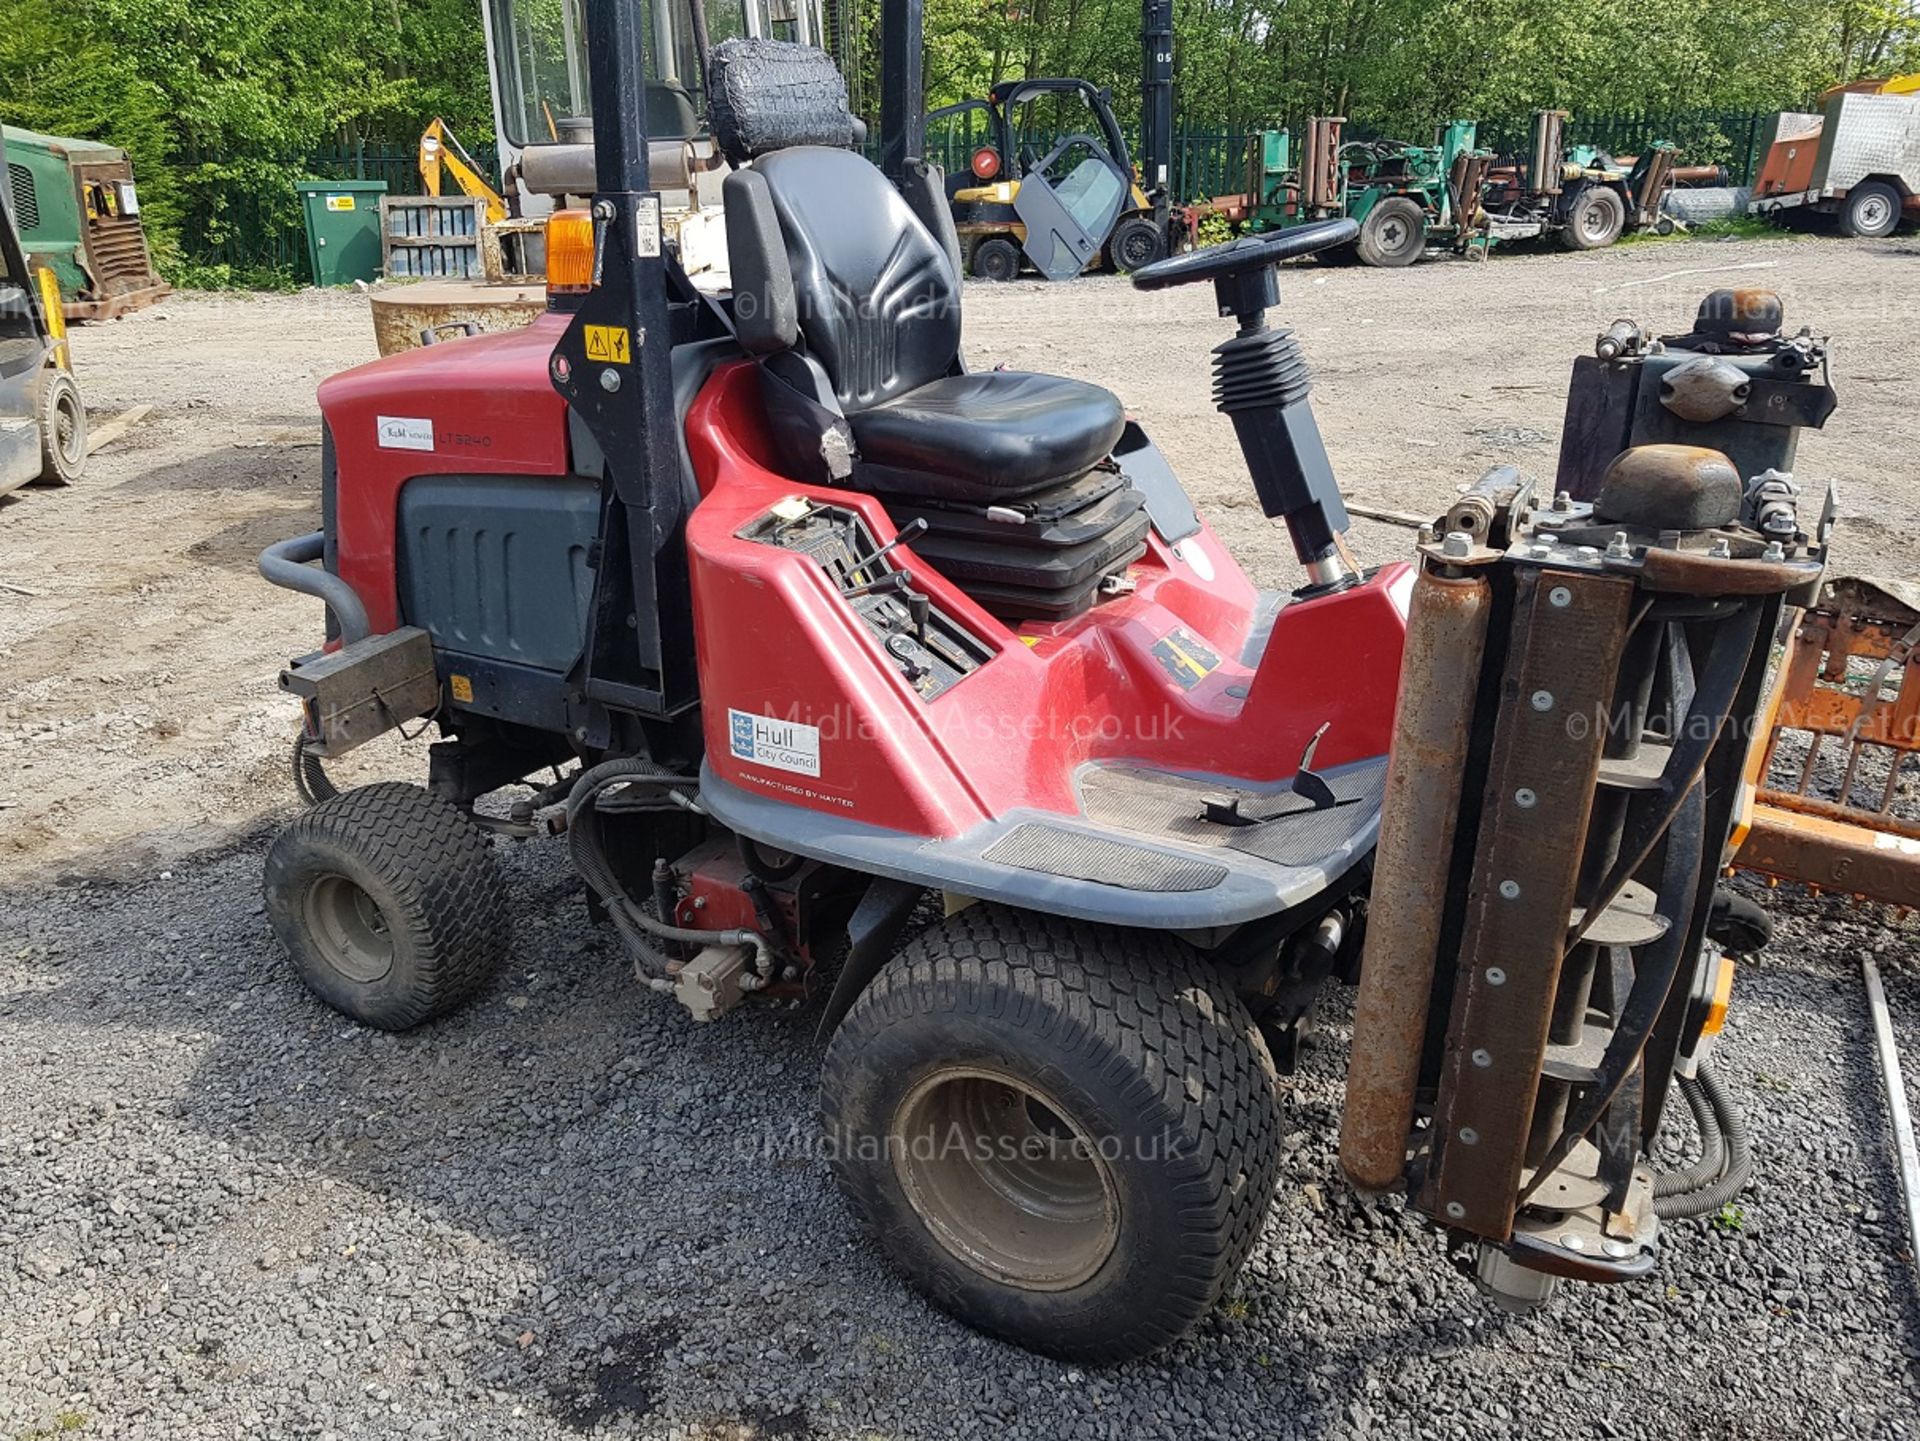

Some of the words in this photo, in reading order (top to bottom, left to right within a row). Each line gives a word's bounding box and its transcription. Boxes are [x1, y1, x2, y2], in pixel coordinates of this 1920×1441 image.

[756, 724, 793, 747] Hull
[756, 748, 777, 762] City
[778, 752, 817, 769] Council
[740, 773, 803, 794] MANUFACTURED
[805, 790, 818, 799] BY
[820, 795, 854, 807] HAYTER
